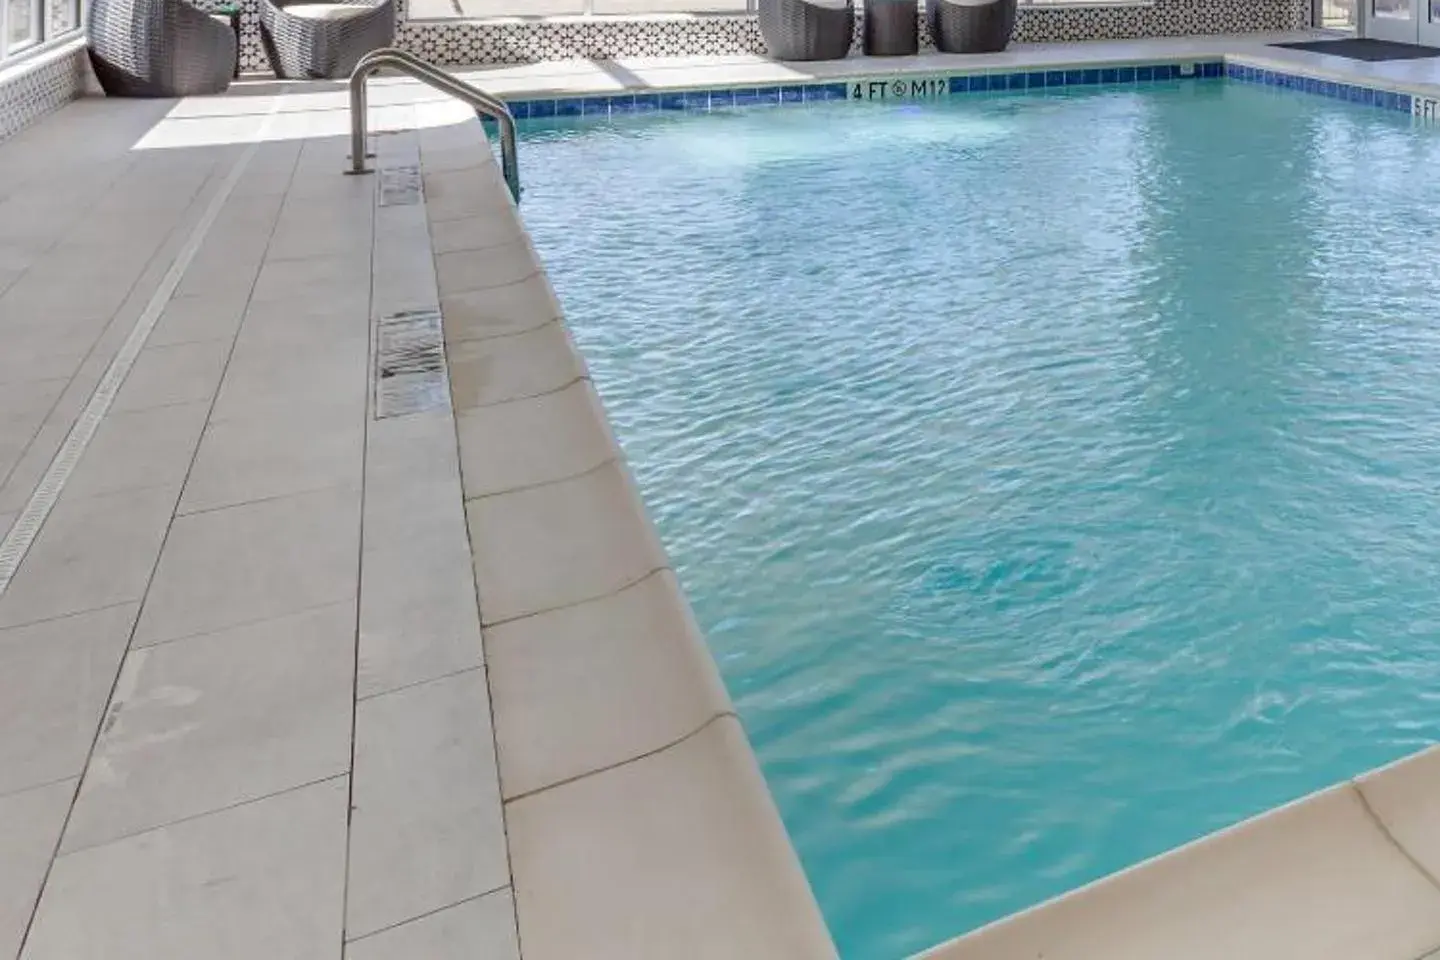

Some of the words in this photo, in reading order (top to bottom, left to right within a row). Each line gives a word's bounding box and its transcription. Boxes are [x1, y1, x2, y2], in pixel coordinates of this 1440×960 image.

[853, 83, 862, 99] 4
[869, 81, 887, 100] FT
[1424, 99, 1437, 120] FT
